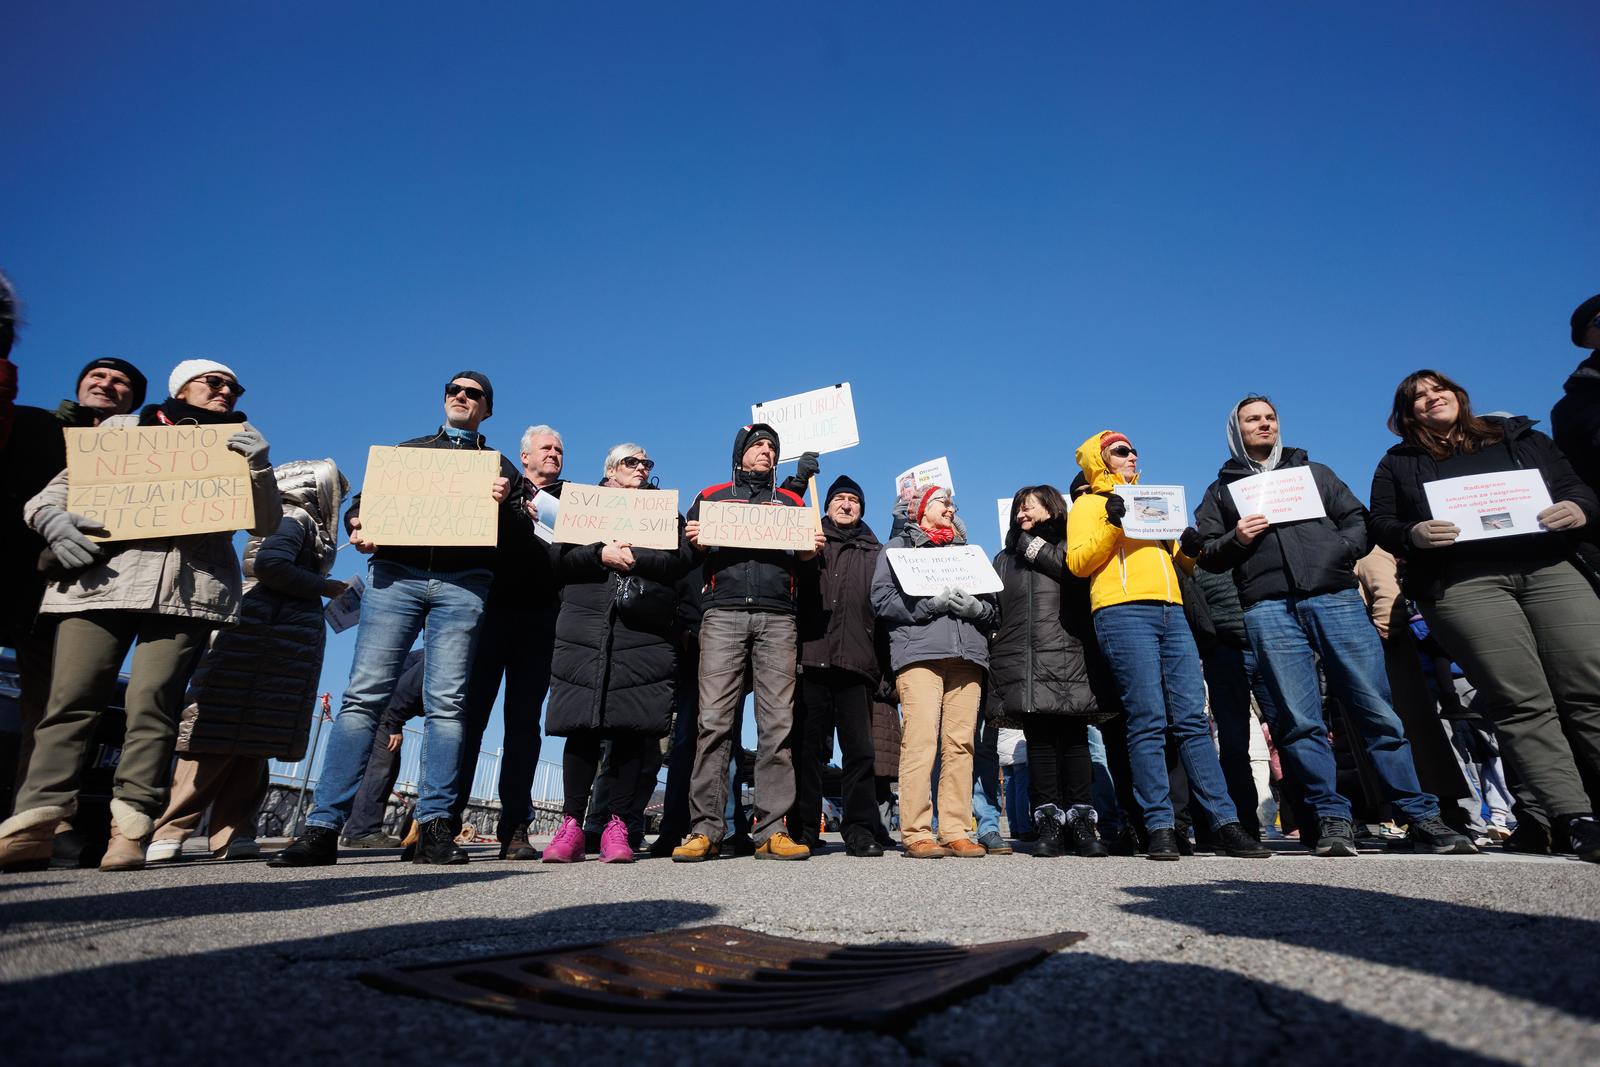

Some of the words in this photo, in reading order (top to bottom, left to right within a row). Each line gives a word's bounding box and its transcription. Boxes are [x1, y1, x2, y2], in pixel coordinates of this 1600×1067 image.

[78, 428, 217, 453] UČINIMO
[72, 484, 165, 507] ZEMLJA
[181, 477, 248, 500] MORE
[378, 470, 465, 494] MORE
[181, 497, 248, 525] ČISTI
[367, 495, 400, 517] ZA
[569, 491, 600, 507] SVI
[603, 496, 628, 510] ZA
[634, 496, 674, 511] MORE
[365, 516, 495, 537] GENERACIJE
[562, 513, 608, 529] MORE
[611, 517, 634, 531] ZA
[639, 518, 675, 532] SVIH
[705, 503, 761, 526] ČISTO
[764, 506, 805, 528] MORE
[702, 523, 752, 541] ČISTA
[753, 525, 814, 542] SAVJEST
